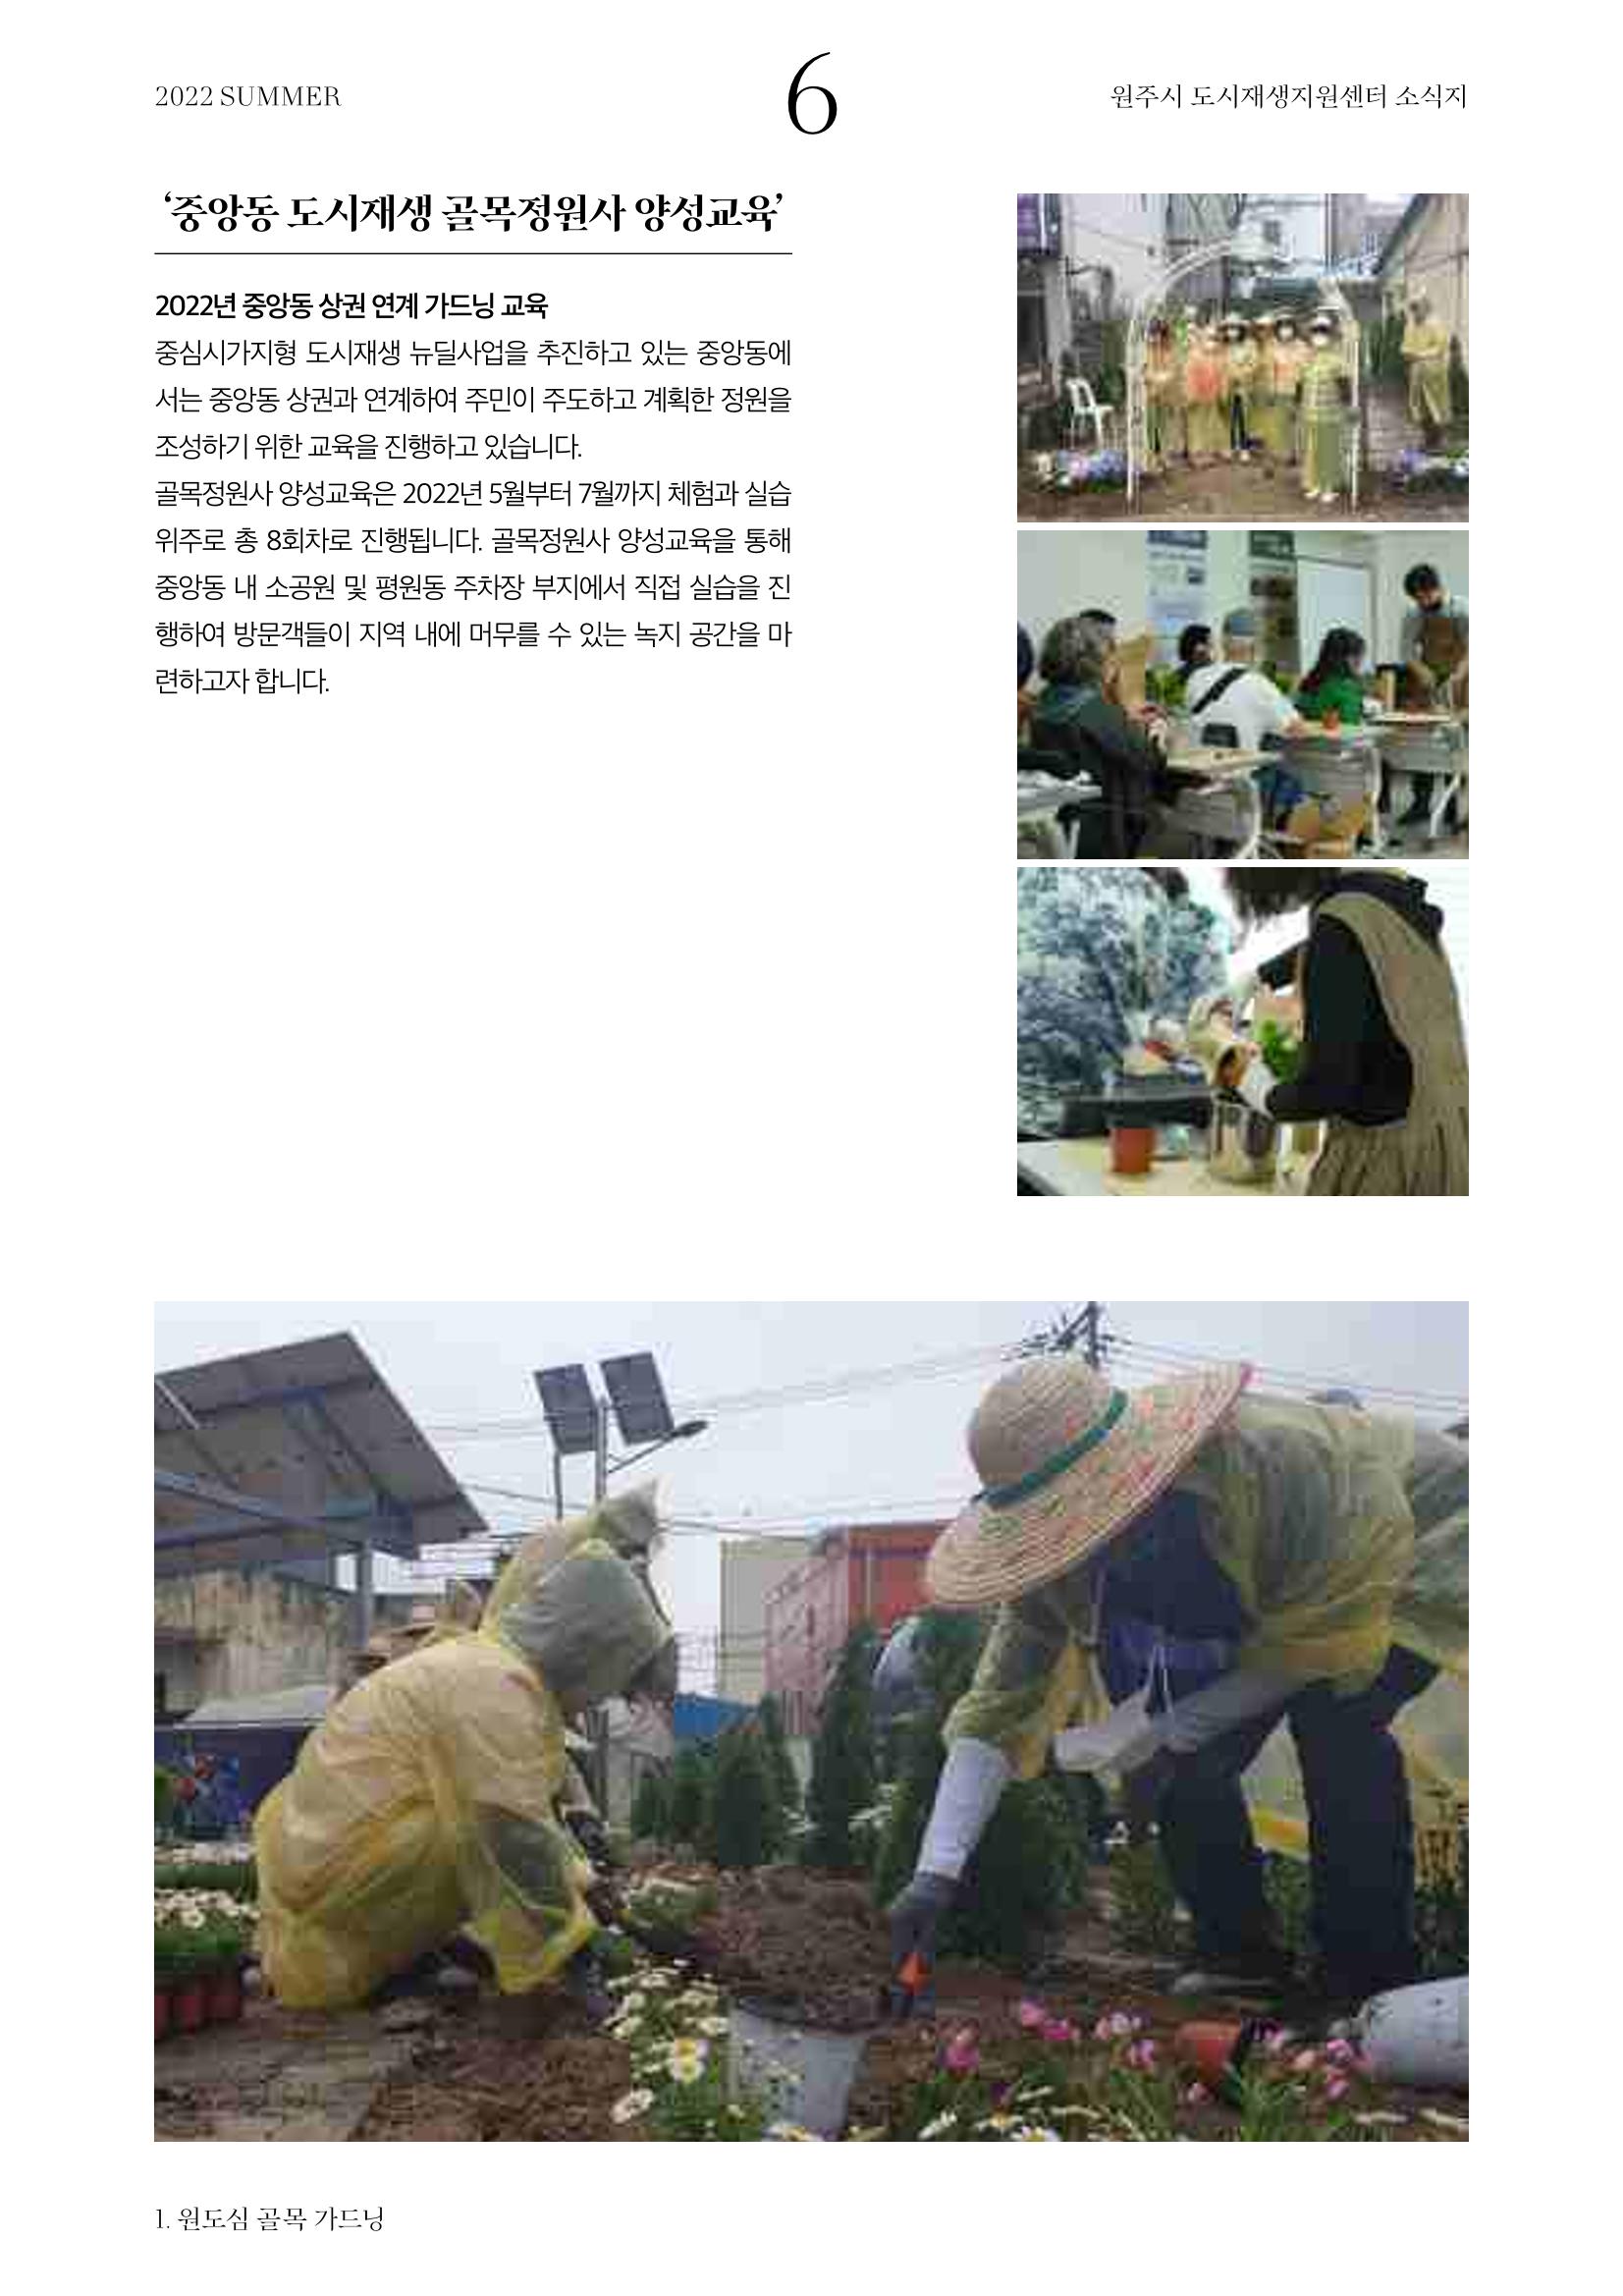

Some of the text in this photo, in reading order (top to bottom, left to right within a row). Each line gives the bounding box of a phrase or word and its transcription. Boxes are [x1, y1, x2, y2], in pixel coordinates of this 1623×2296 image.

[156, 85, 341, 107] 2022 SUMMER
[788, 52, 839, 136] 6
[1110, 83, 1467, 109] 원주시 도시재생지원센터 소식지
[165, 191, 783, 232] ‘중앙동 도시재생 골목정원사 양성교육’
[156, 293, 548, 319] 2022년 중앙동 상권 연계 가드닝 교육
[155, 340, 790, 365] 중심시가지형 도시재생 뉴딜사업을 추진하고 있는 중앙동에
[156, 387, 791, 412] 서는 중앙동 상권과 연계하여 주민이 주도하고 계획한 정원을
[155, 434, 581, 460] 조성하기 위한 교육을 진행하고 있습니다.
[155, 480, 791, 507] 골목정원사 양성교육은 2022년 5월부터 7월까지 체험과 실습
[155, 527, 790, 553] 위주로 총 8회차로 진행됩니다. 골목정원사 양성교육을 통해
[155, 574, 789, 600] 중앙동 내 소공원 및 평원동 주차장 부지에서 직접 실습을 진
[155, 622, 792, 647] 행하여 방문객들이 지역 내에 머무를 수 있는 녹지 공간을 마
[156, 669, 329, 694] 련하고자 합니다.
[156, 2207, 383, 2231] 1. 원도심 골목 가드닝
